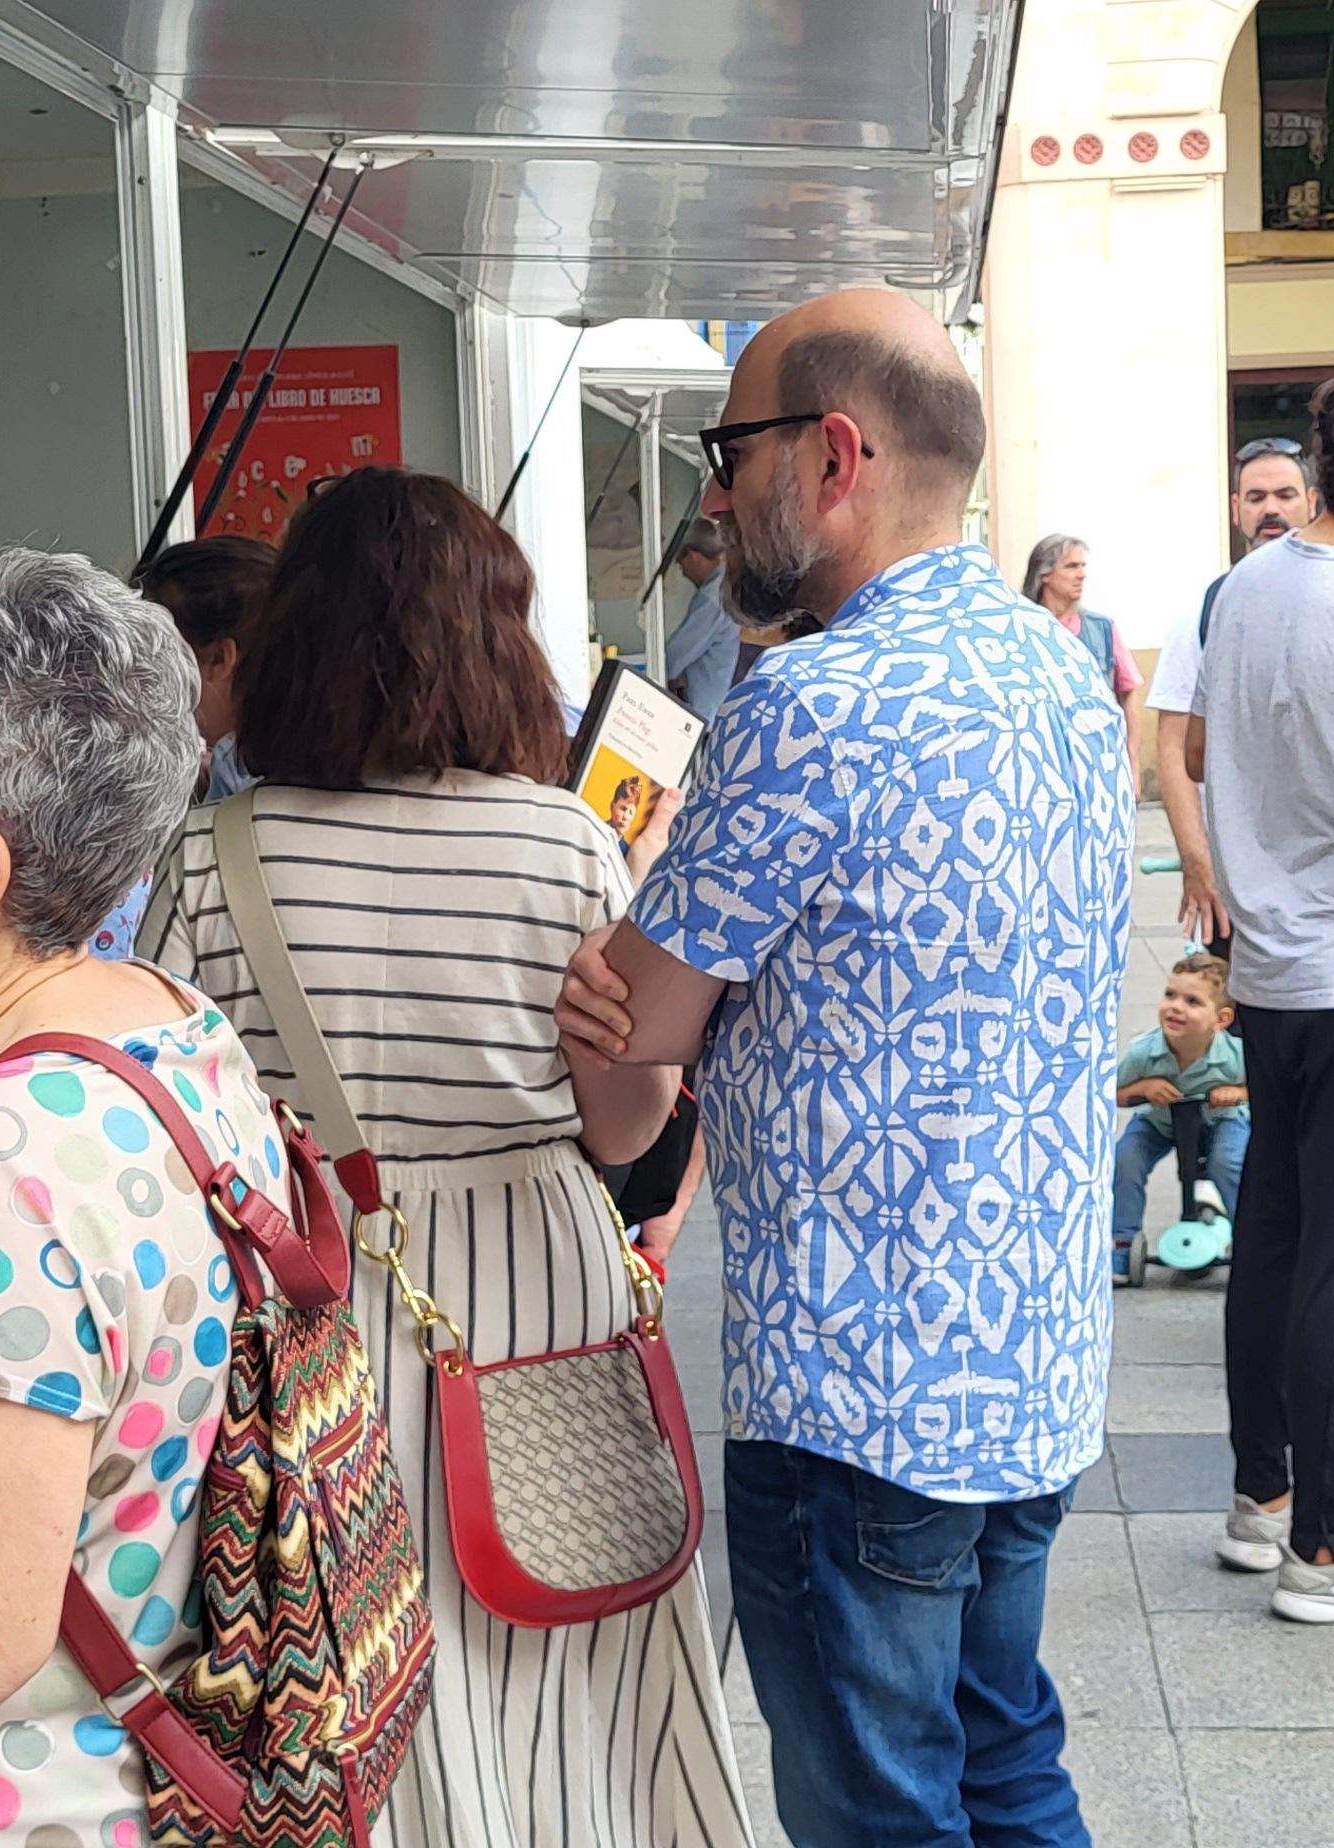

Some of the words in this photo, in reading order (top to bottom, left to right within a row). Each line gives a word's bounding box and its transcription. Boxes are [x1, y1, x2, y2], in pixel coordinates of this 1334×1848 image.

[269, 389, 306, 408] LIBRO
[310, 388, 326, 406] DE
[330, 386, 381, 406] HUESCA
